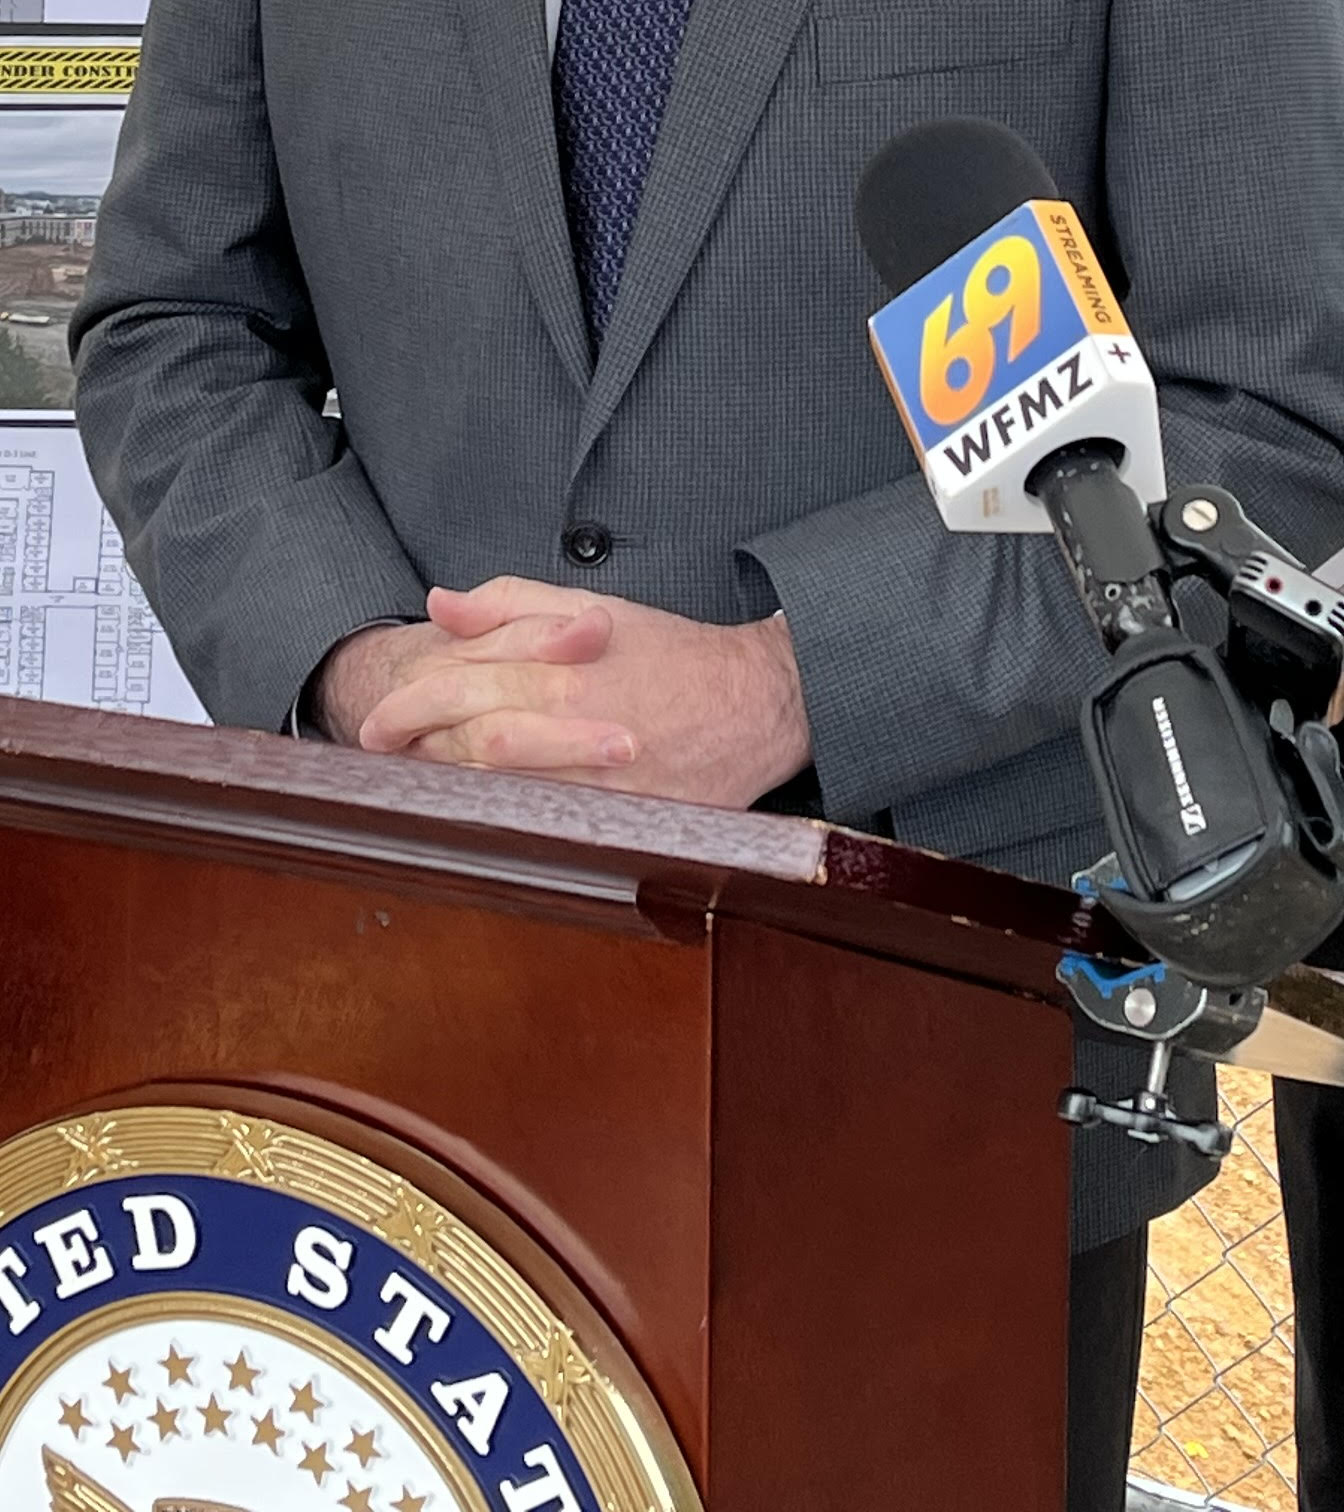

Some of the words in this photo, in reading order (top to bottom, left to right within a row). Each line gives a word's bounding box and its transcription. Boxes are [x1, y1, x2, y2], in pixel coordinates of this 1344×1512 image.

[919, 234, 1041, 427] 69
[1050, 214, 1113, 324] STREAMING
[943, 351, 1094, 477] WFMZ
[287, 1225, 583, 1512] STAT
